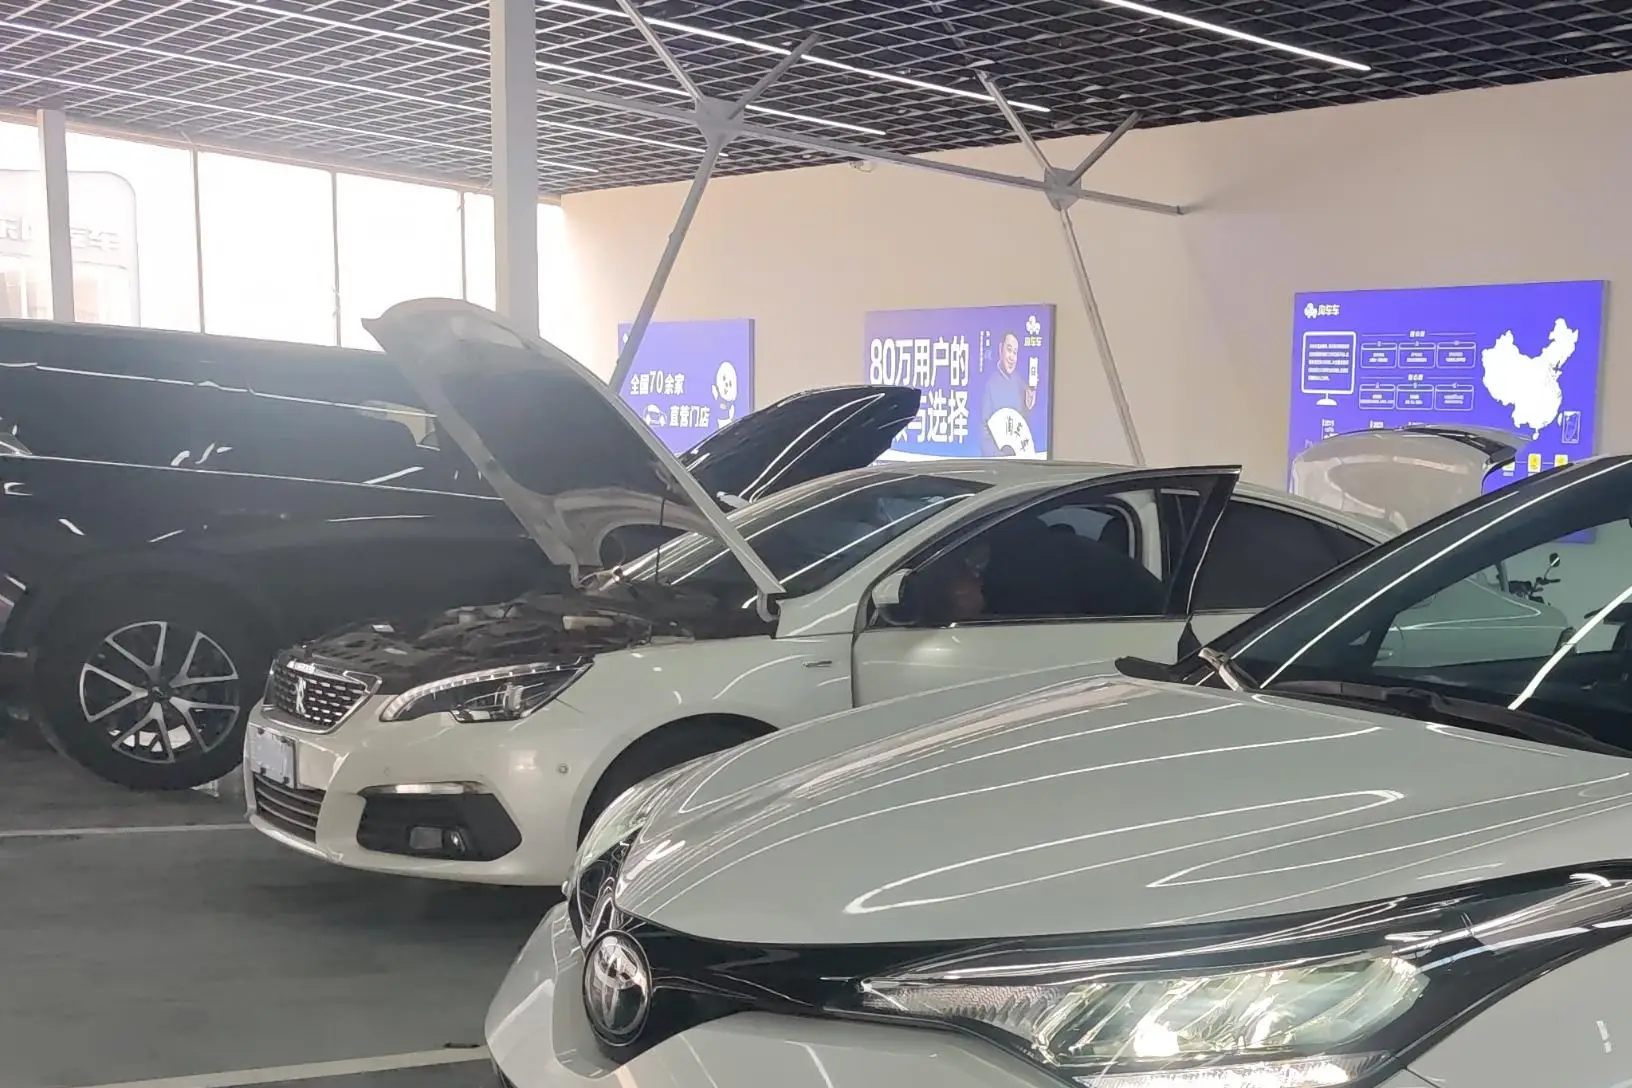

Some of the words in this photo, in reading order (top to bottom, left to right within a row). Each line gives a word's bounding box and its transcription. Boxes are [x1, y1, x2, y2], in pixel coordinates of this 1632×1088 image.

[870, 336, 969, 387] 80万用户的
[669, 405, 710, 427] 直营门店
[895, 389, 969, 444] 与选择
